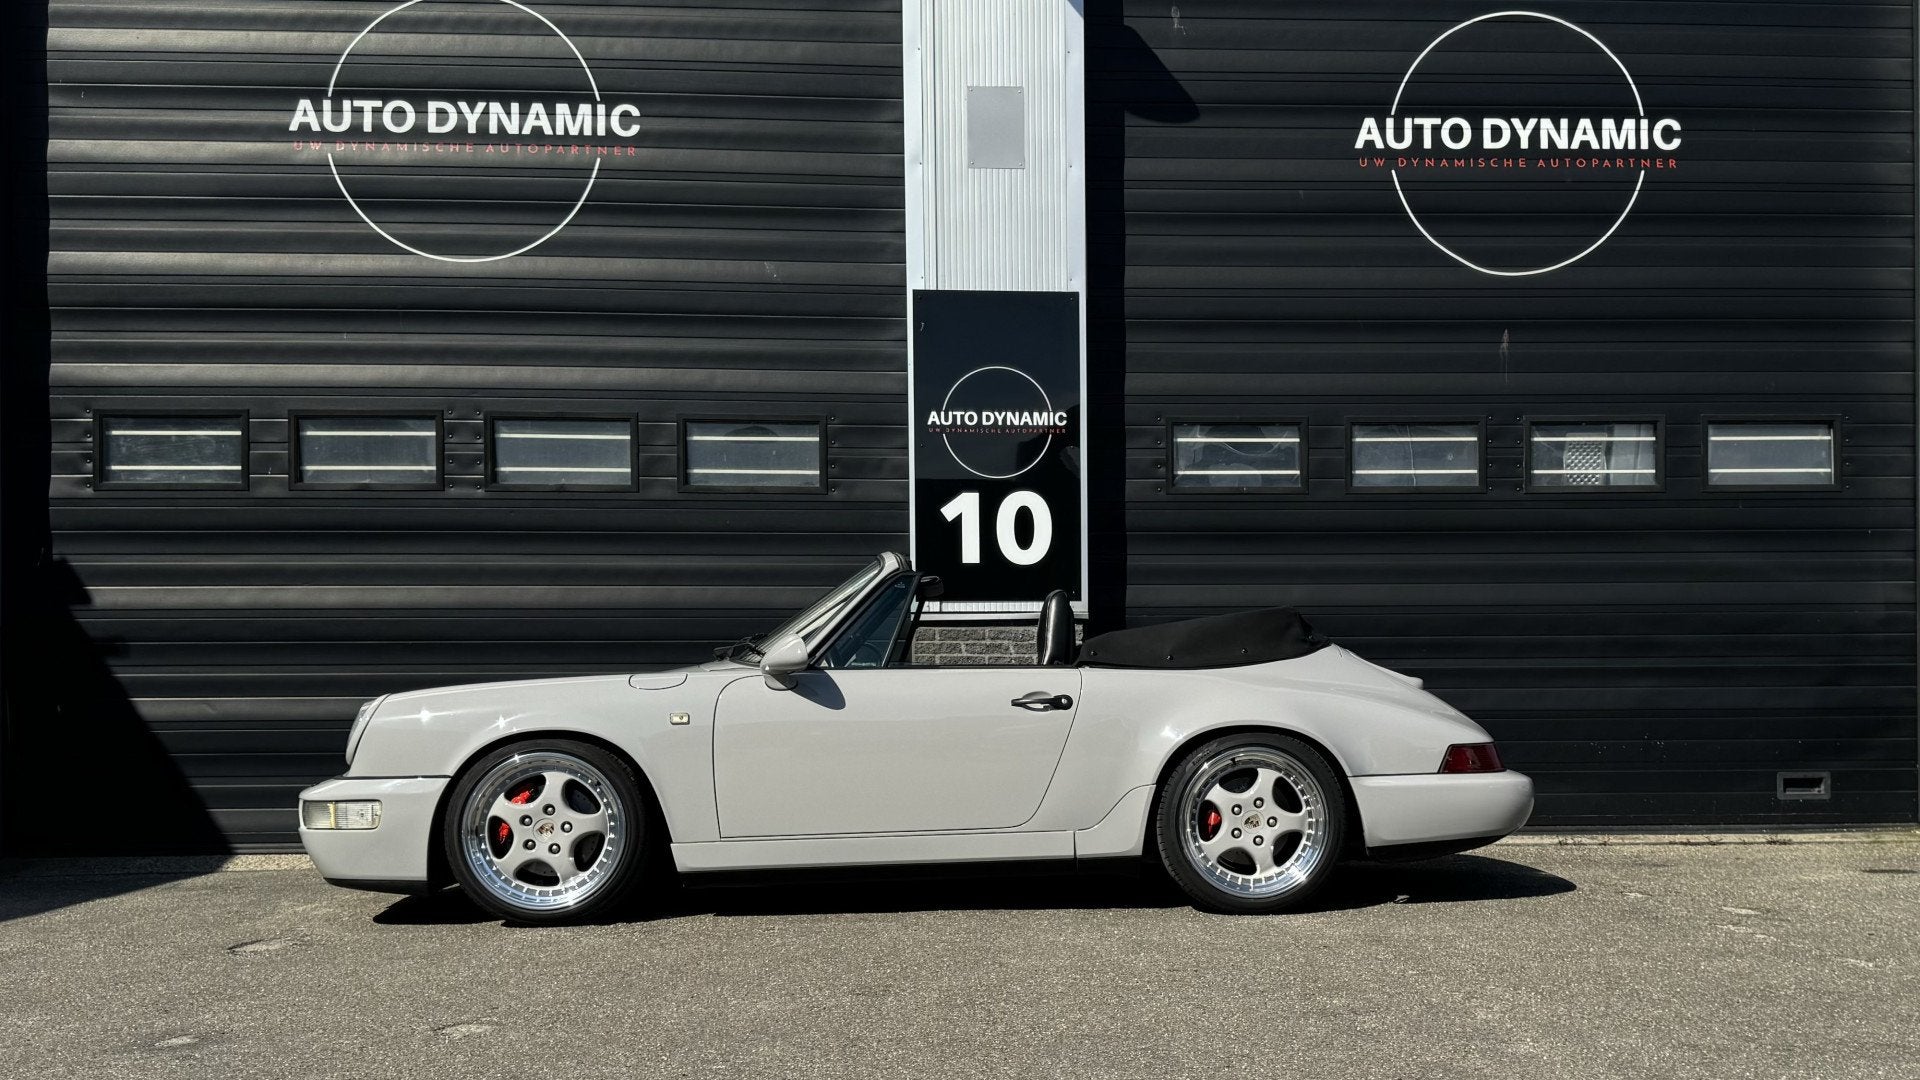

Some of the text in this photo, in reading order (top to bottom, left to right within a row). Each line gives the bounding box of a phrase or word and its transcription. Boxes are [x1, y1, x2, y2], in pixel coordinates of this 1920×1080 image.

[289, 99, 640, 137] AUTO DYNAMIC
[1354, 117, 1682, 150] AUTO DYNAMIC
[293, 141, 636, 156] UW DYNAMISCHE AUTOPARTNER
[1359, 157, 1677, 169] UW DYNAMISCHE AUTOPARTNER
[927, 411, 1067, 426] AUTO DYNAMIC
[940, 490, 1053, 566] 10
